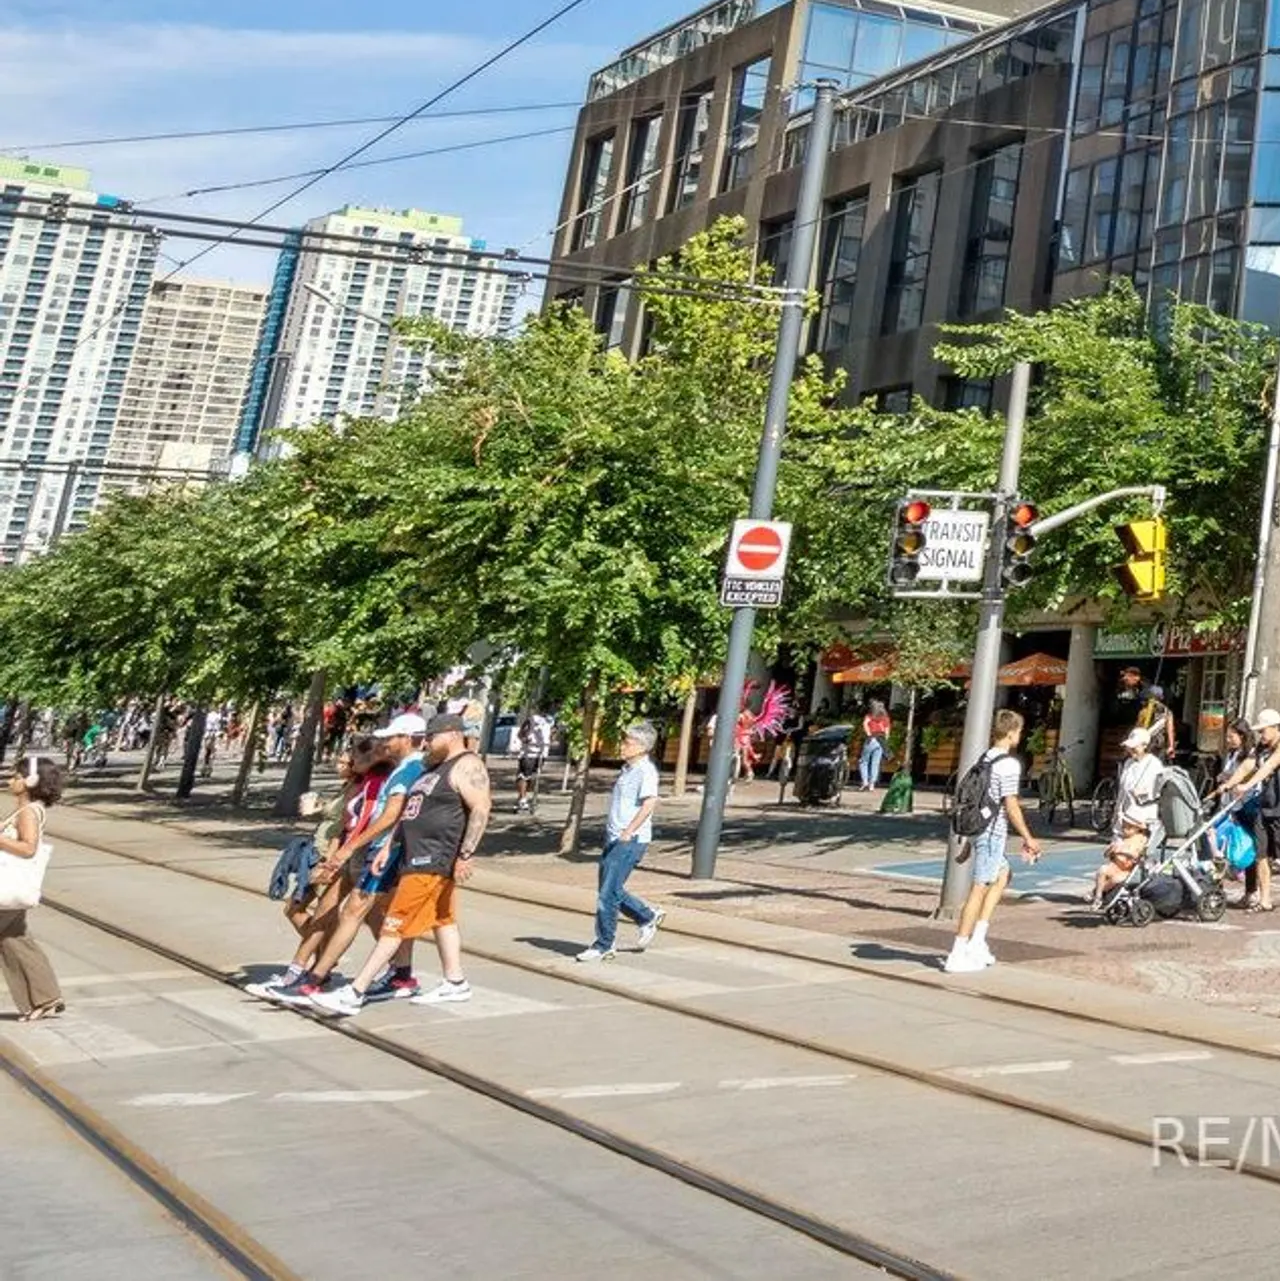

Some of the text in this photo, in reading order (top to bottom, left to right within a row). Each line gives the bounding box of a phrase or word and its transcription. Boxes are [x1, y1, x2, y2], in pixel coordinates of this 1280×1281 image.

[922, 521, 983, 542] TRANSIT
[920, 548, 975, 568] SIGNAL
[727, 580, 744, 590] TTC
[726, 592, 777, 602] EXCEPTED
